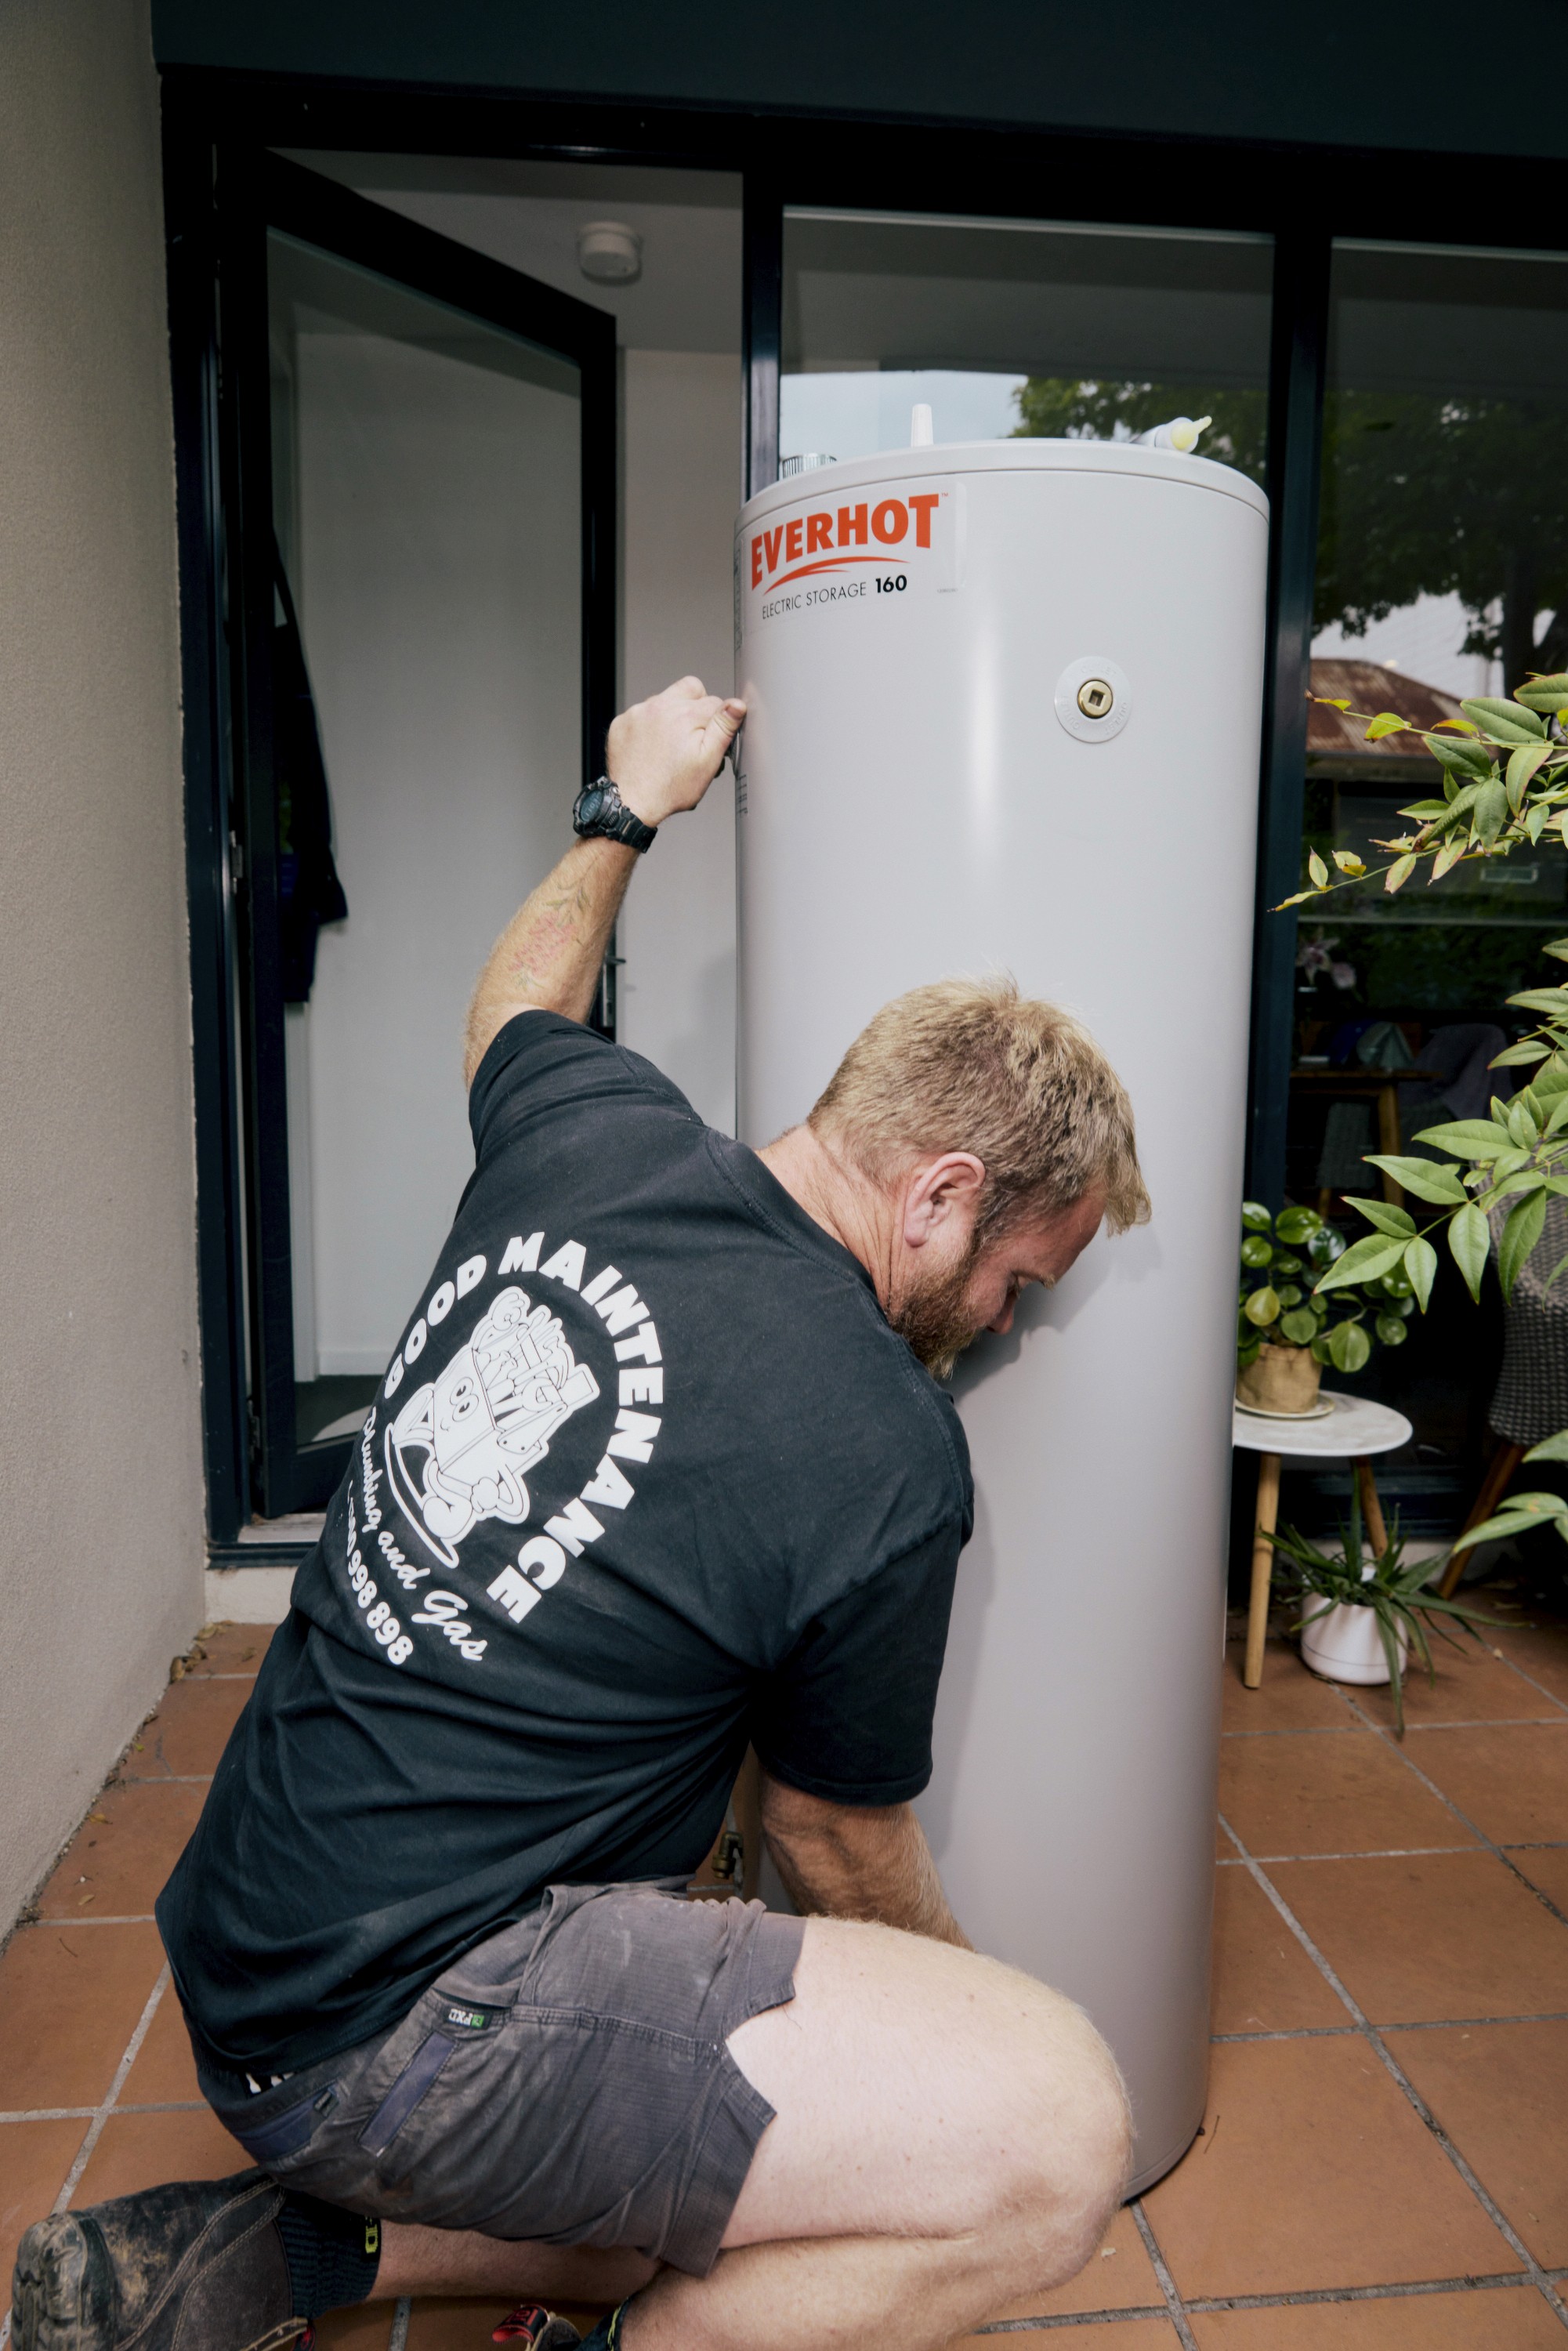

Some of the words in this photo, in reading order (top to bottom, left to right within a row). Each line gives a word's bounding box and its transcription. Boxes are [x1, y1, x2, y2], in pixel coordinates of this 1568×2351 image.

[751, 493, 939, 591] EVERHOT
[762, 594, 802, 619] ELECTRIC
[806, 581, 867, 606] STORAGE
[875, 574, 907, 593] 160
[384, 1254, 487, 1399] GOOD
[486, 1231, 664, 1624] MAINTENANCE
[361, 1406, 383, 1533] Plumbing
[378, 1531, 430, 1589] and
[411, 1590, 487, 1661] Gas
[347, 1549, 378, 1609] 998
[366, 1601, 414, 1665] 898
